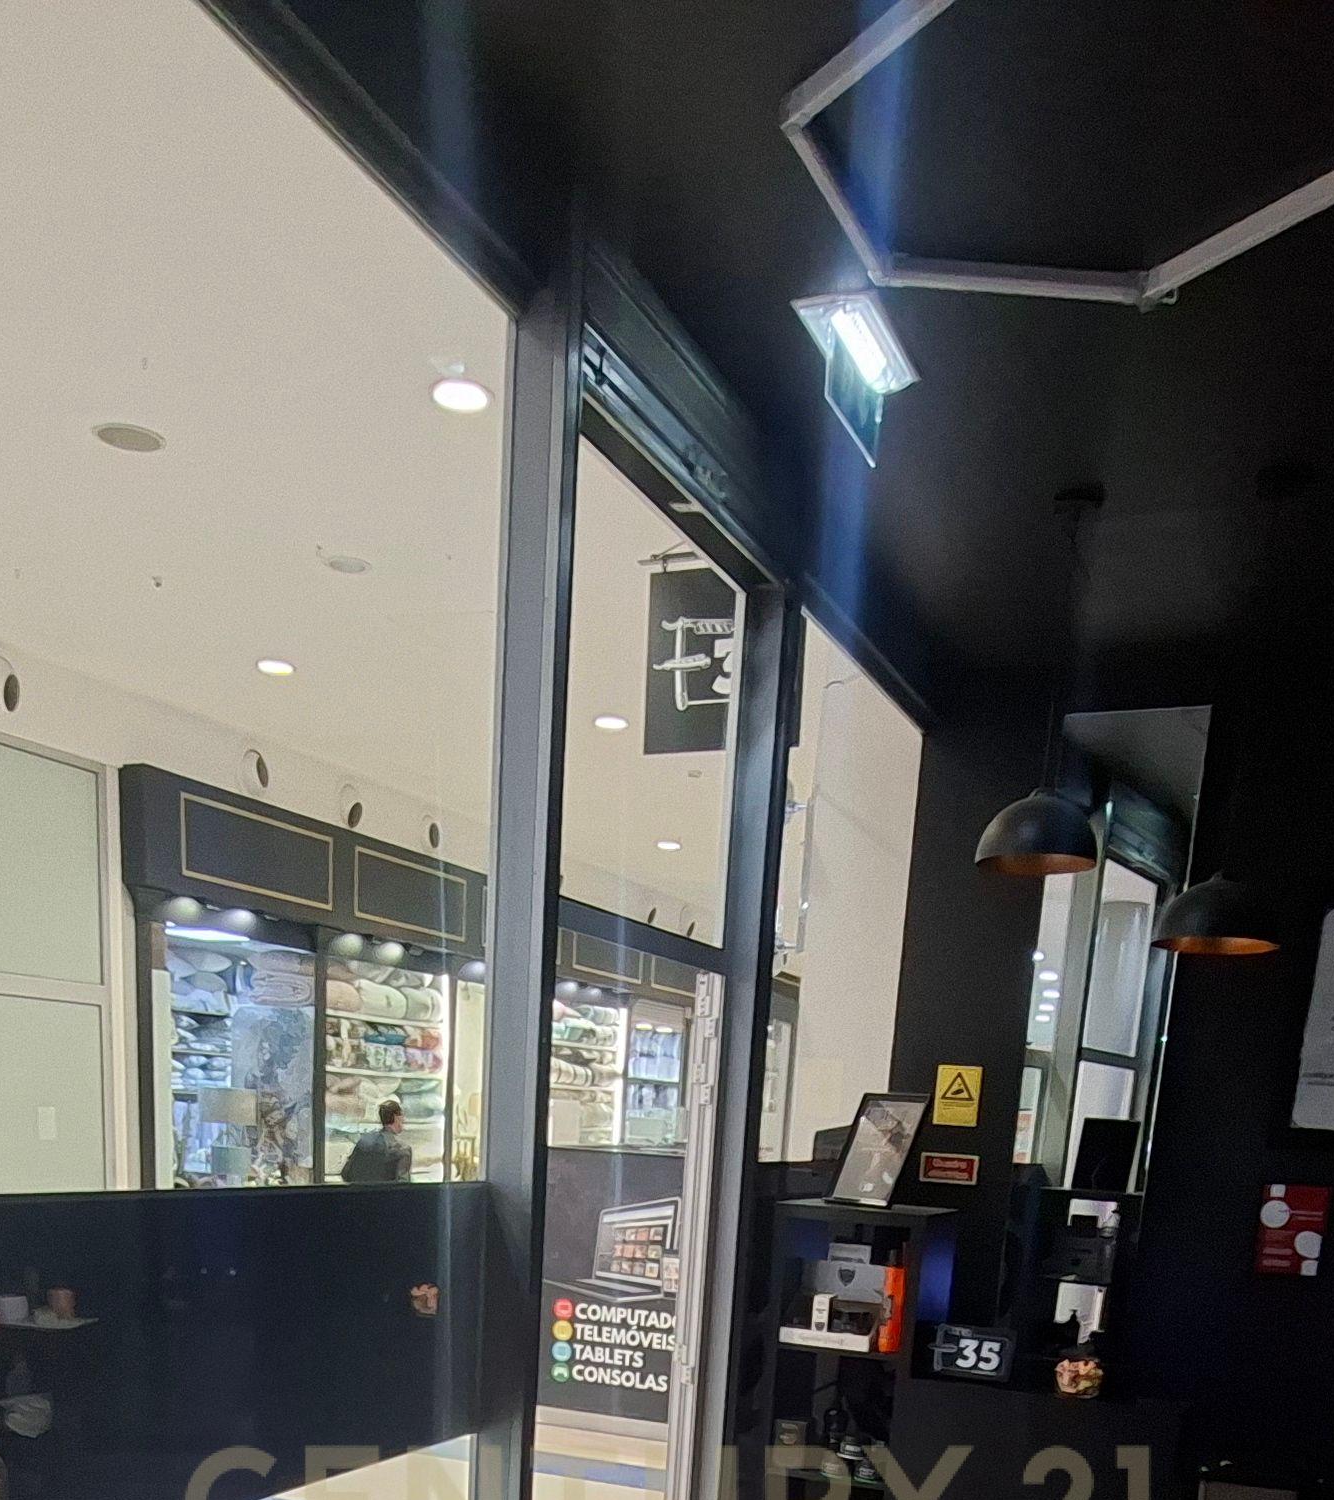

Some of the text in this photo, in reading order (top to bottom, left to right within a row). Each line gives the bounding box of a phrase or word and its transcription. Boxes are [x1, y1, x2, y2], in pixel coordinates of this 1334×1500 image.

[574, 1323, 676, 1351] TELEMÓVEIS
[573, 1344, 644, 1368] TABLETS
[571, 1365, 668, 1392] CONSOLAS
